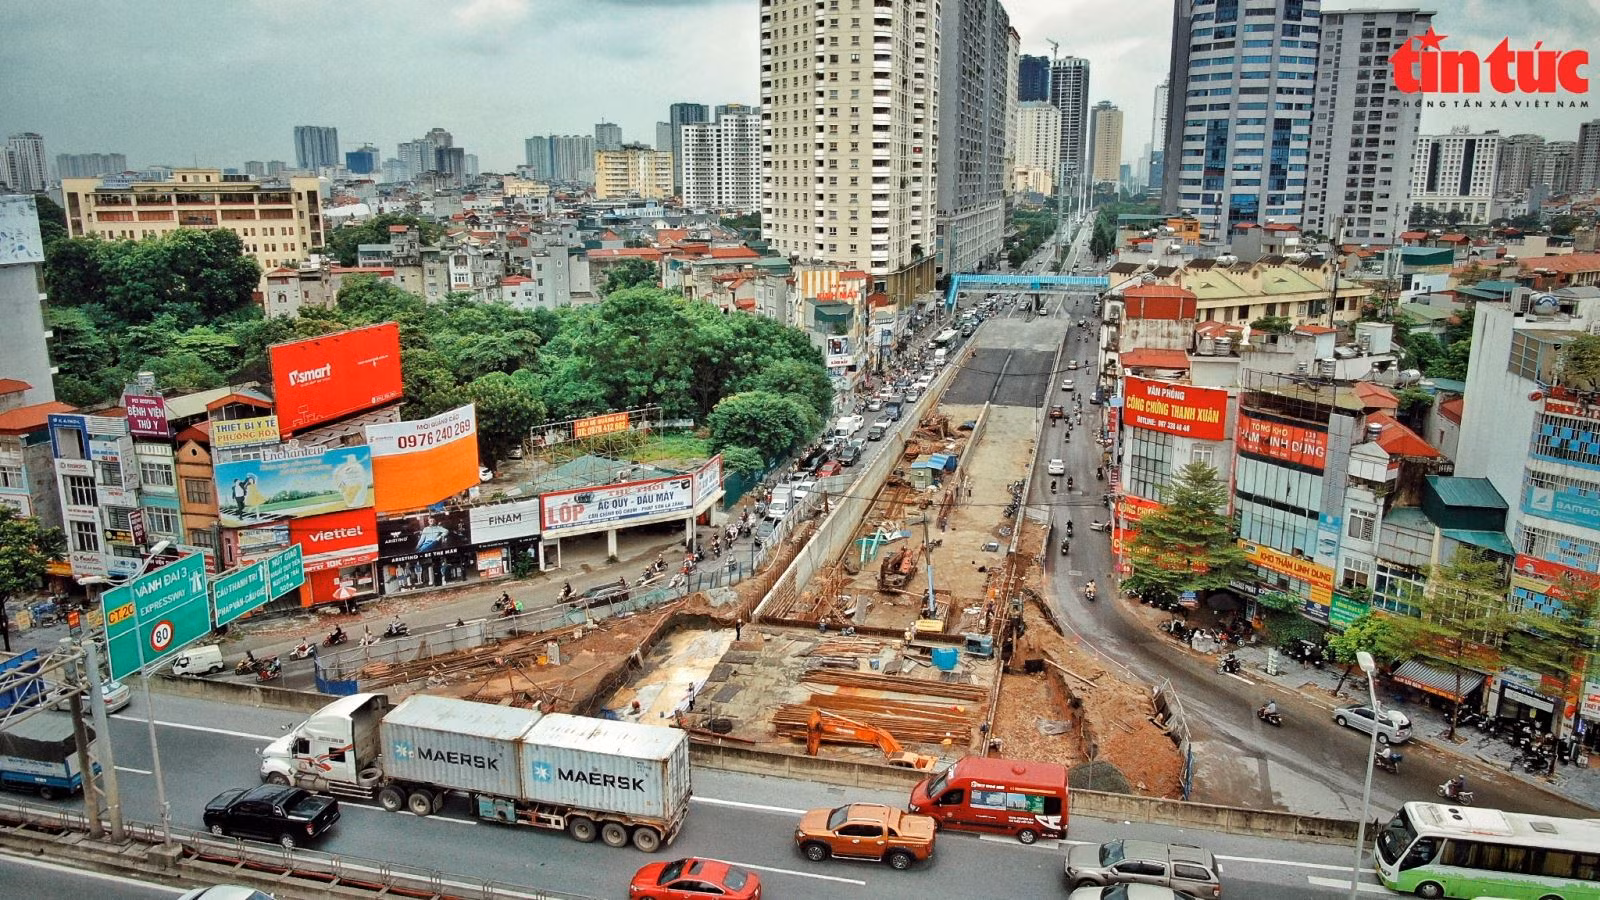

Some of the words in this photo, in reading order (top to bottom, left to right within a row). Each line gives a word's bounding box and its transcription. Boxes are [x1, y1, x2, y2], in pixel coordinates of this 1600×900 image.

[127, 404, 147, 418] BỆNH
[147, 406, 165, 420] VIỆN
[1126, 394, 1145, 412] CÔNG
[1171, 404, 1196, 421] THANH
[152, 419, 159, 430] Y
[397, 432, 434, 449] 0976
[435, 425, 453, 444] 240
[454, 419, 471, 436] 269
[488, 512, 522, 526] FINAM
[309, 525, 364, 543] viettel
[135, 578, 162, 598] VÀNH
[163, 569, 180, 587] ĐAI
[181, 567, 188, 578] 3
[140, 589, 186, 617] EXPRESSWAY
[156, 627, 169, 643] 80
[417, 746, 498, 771] MAERSK
[557, 767, 646, 793] MAERSK
